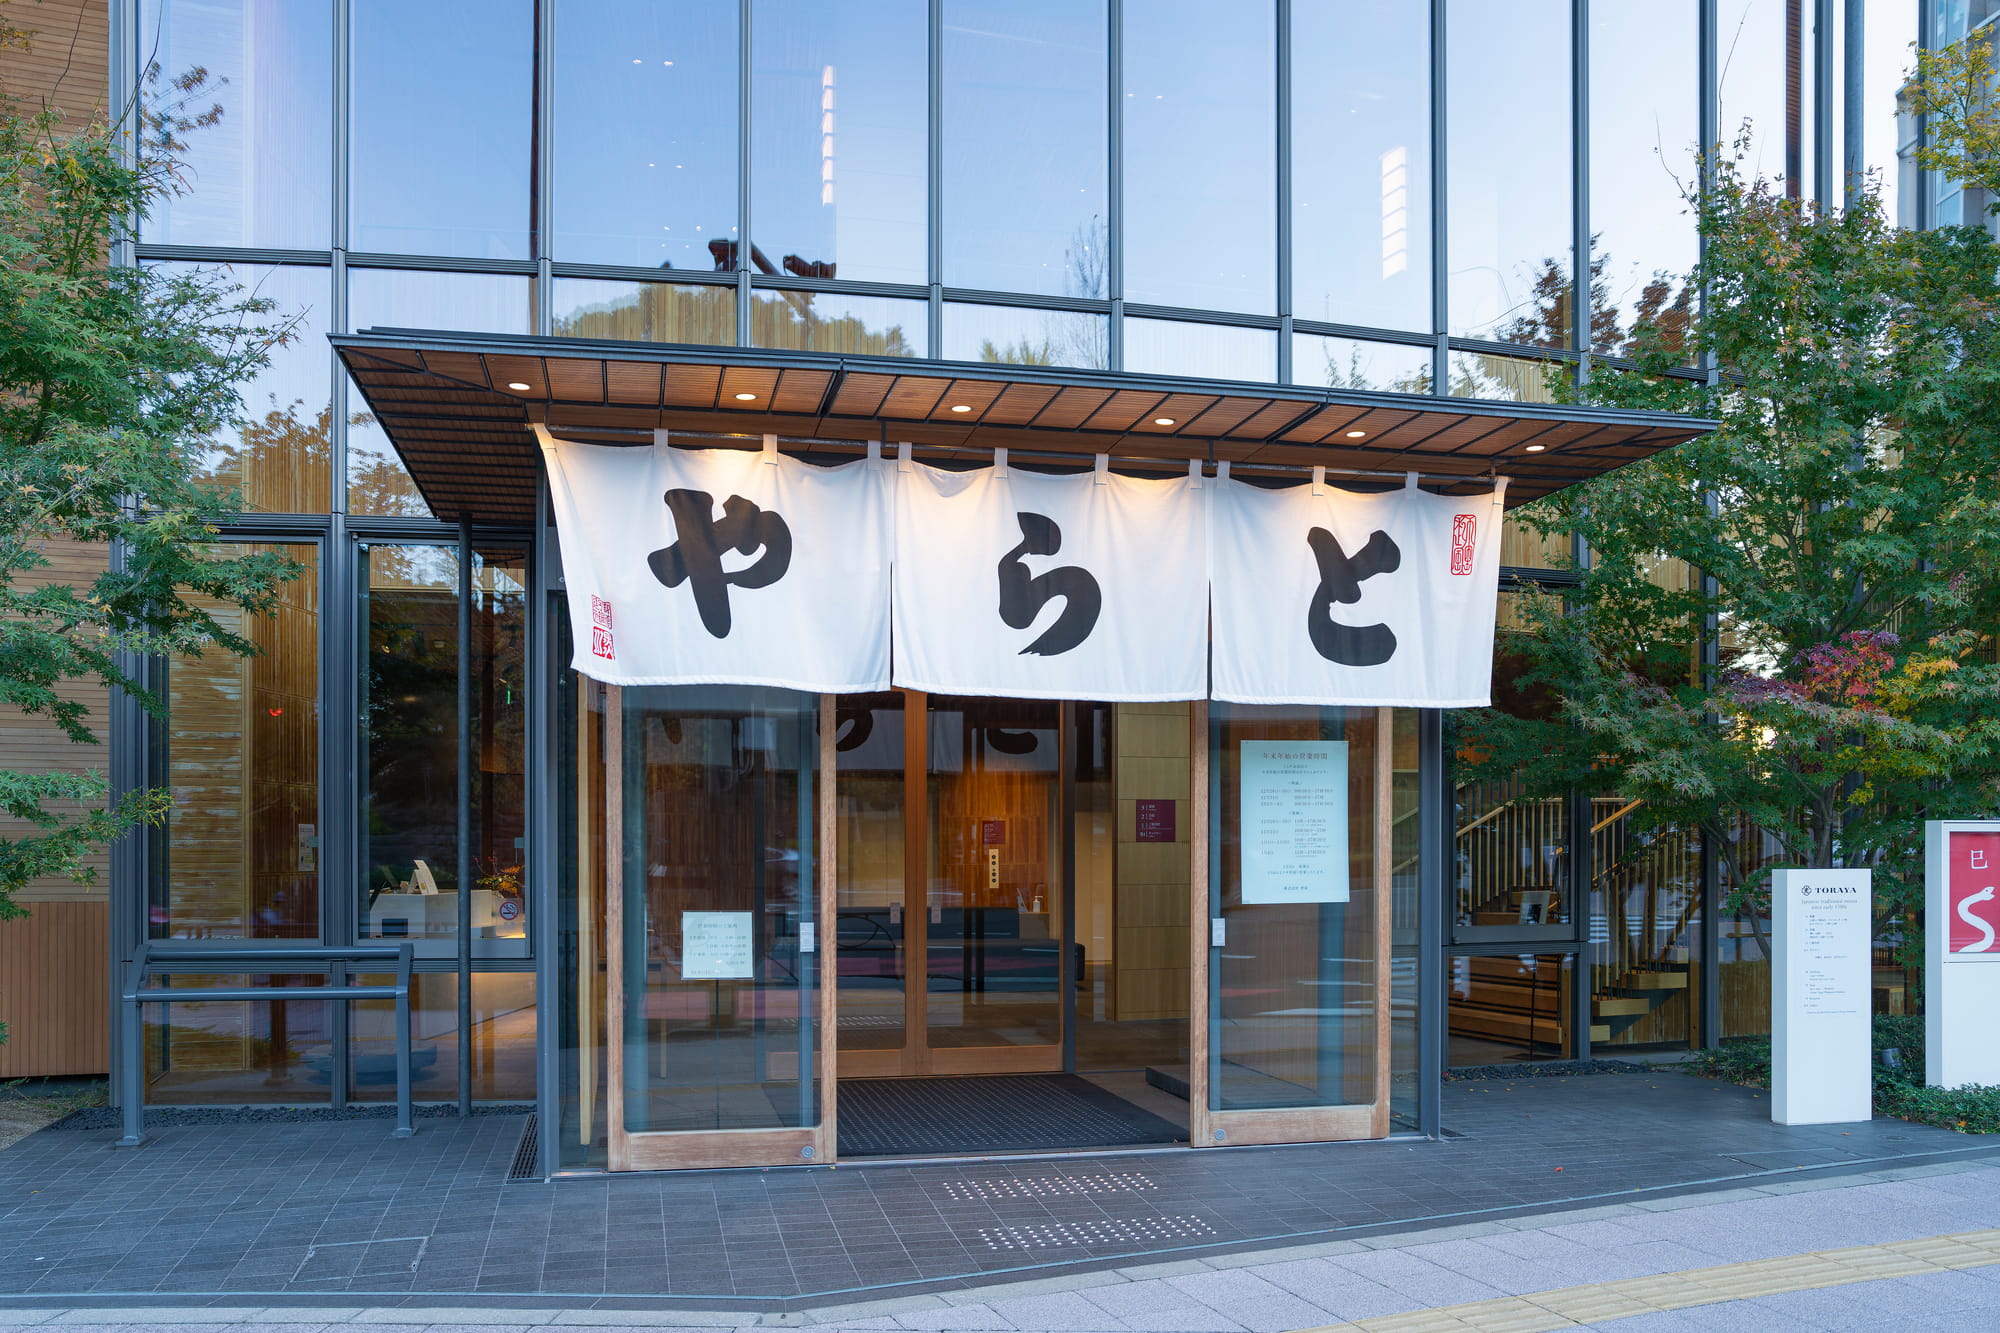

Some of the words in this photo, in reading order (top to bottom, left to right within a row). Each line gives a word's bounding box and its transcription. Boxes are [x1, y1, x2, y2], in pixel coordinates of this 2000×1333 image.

[648, 489, 792, 638] や
[998, 512, 1101, 656] ら
[1308, 527, 1400, 666] と
[1263, 752, 1328, 760] 年末年始の営業時間
[1970, 850, 1988, 869] 巳
